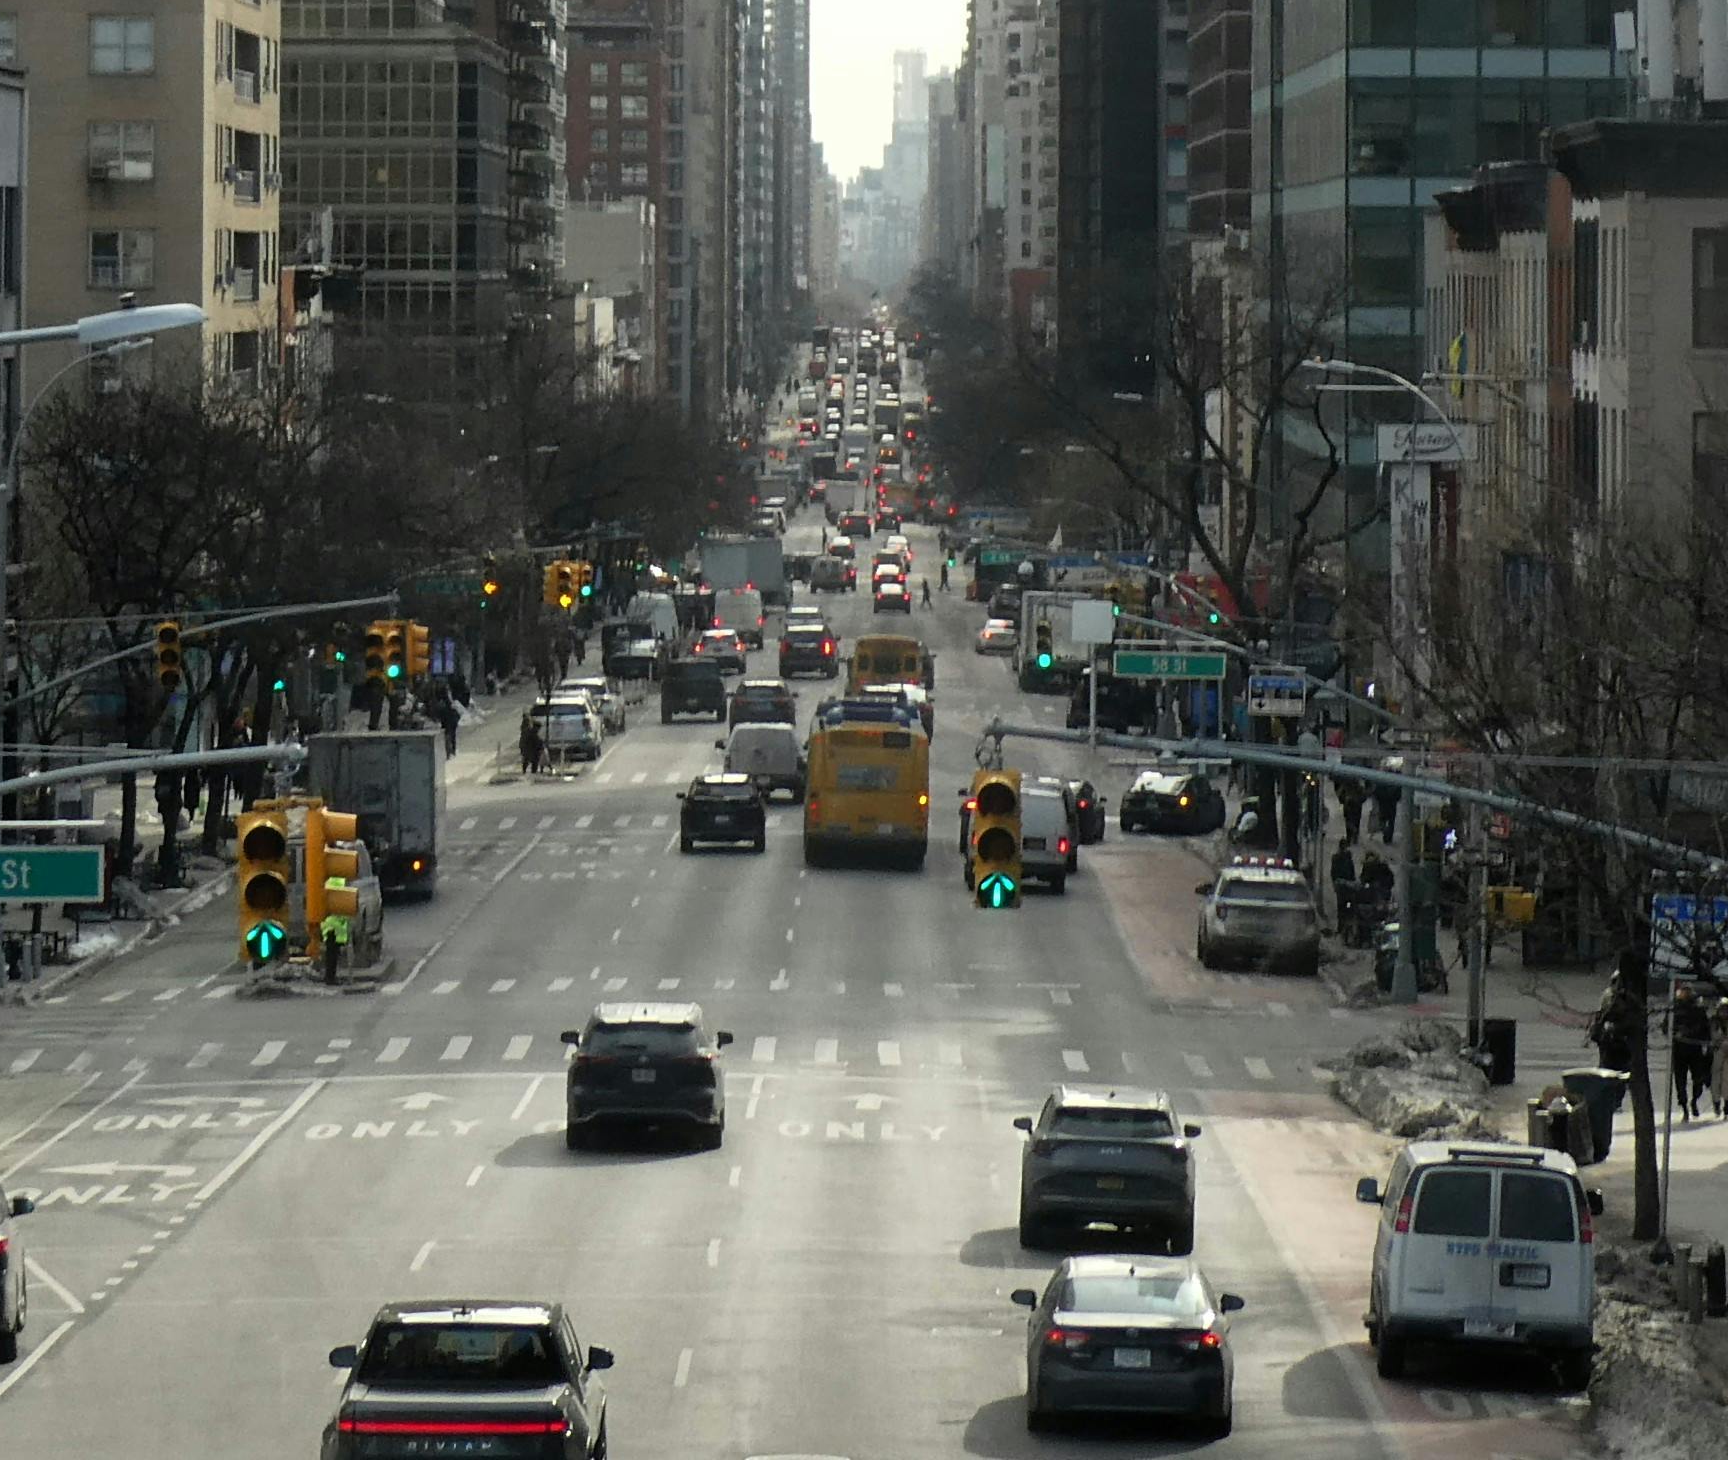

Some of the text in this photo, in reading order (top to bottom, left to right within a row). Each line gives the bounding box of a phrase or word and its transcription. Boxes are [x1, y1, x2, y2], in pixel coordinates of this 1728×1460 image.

[1, 859, 33, 890] St
[93, 1113, 280, 1132] ONLY
[304, 1119, 483, 1140] ONLY
[778, 1120, 950, 1141] ONLY
[1447, 1242, 1480, 1256] NYPD
[407, 1441, 493, 1452] RIVIAN
